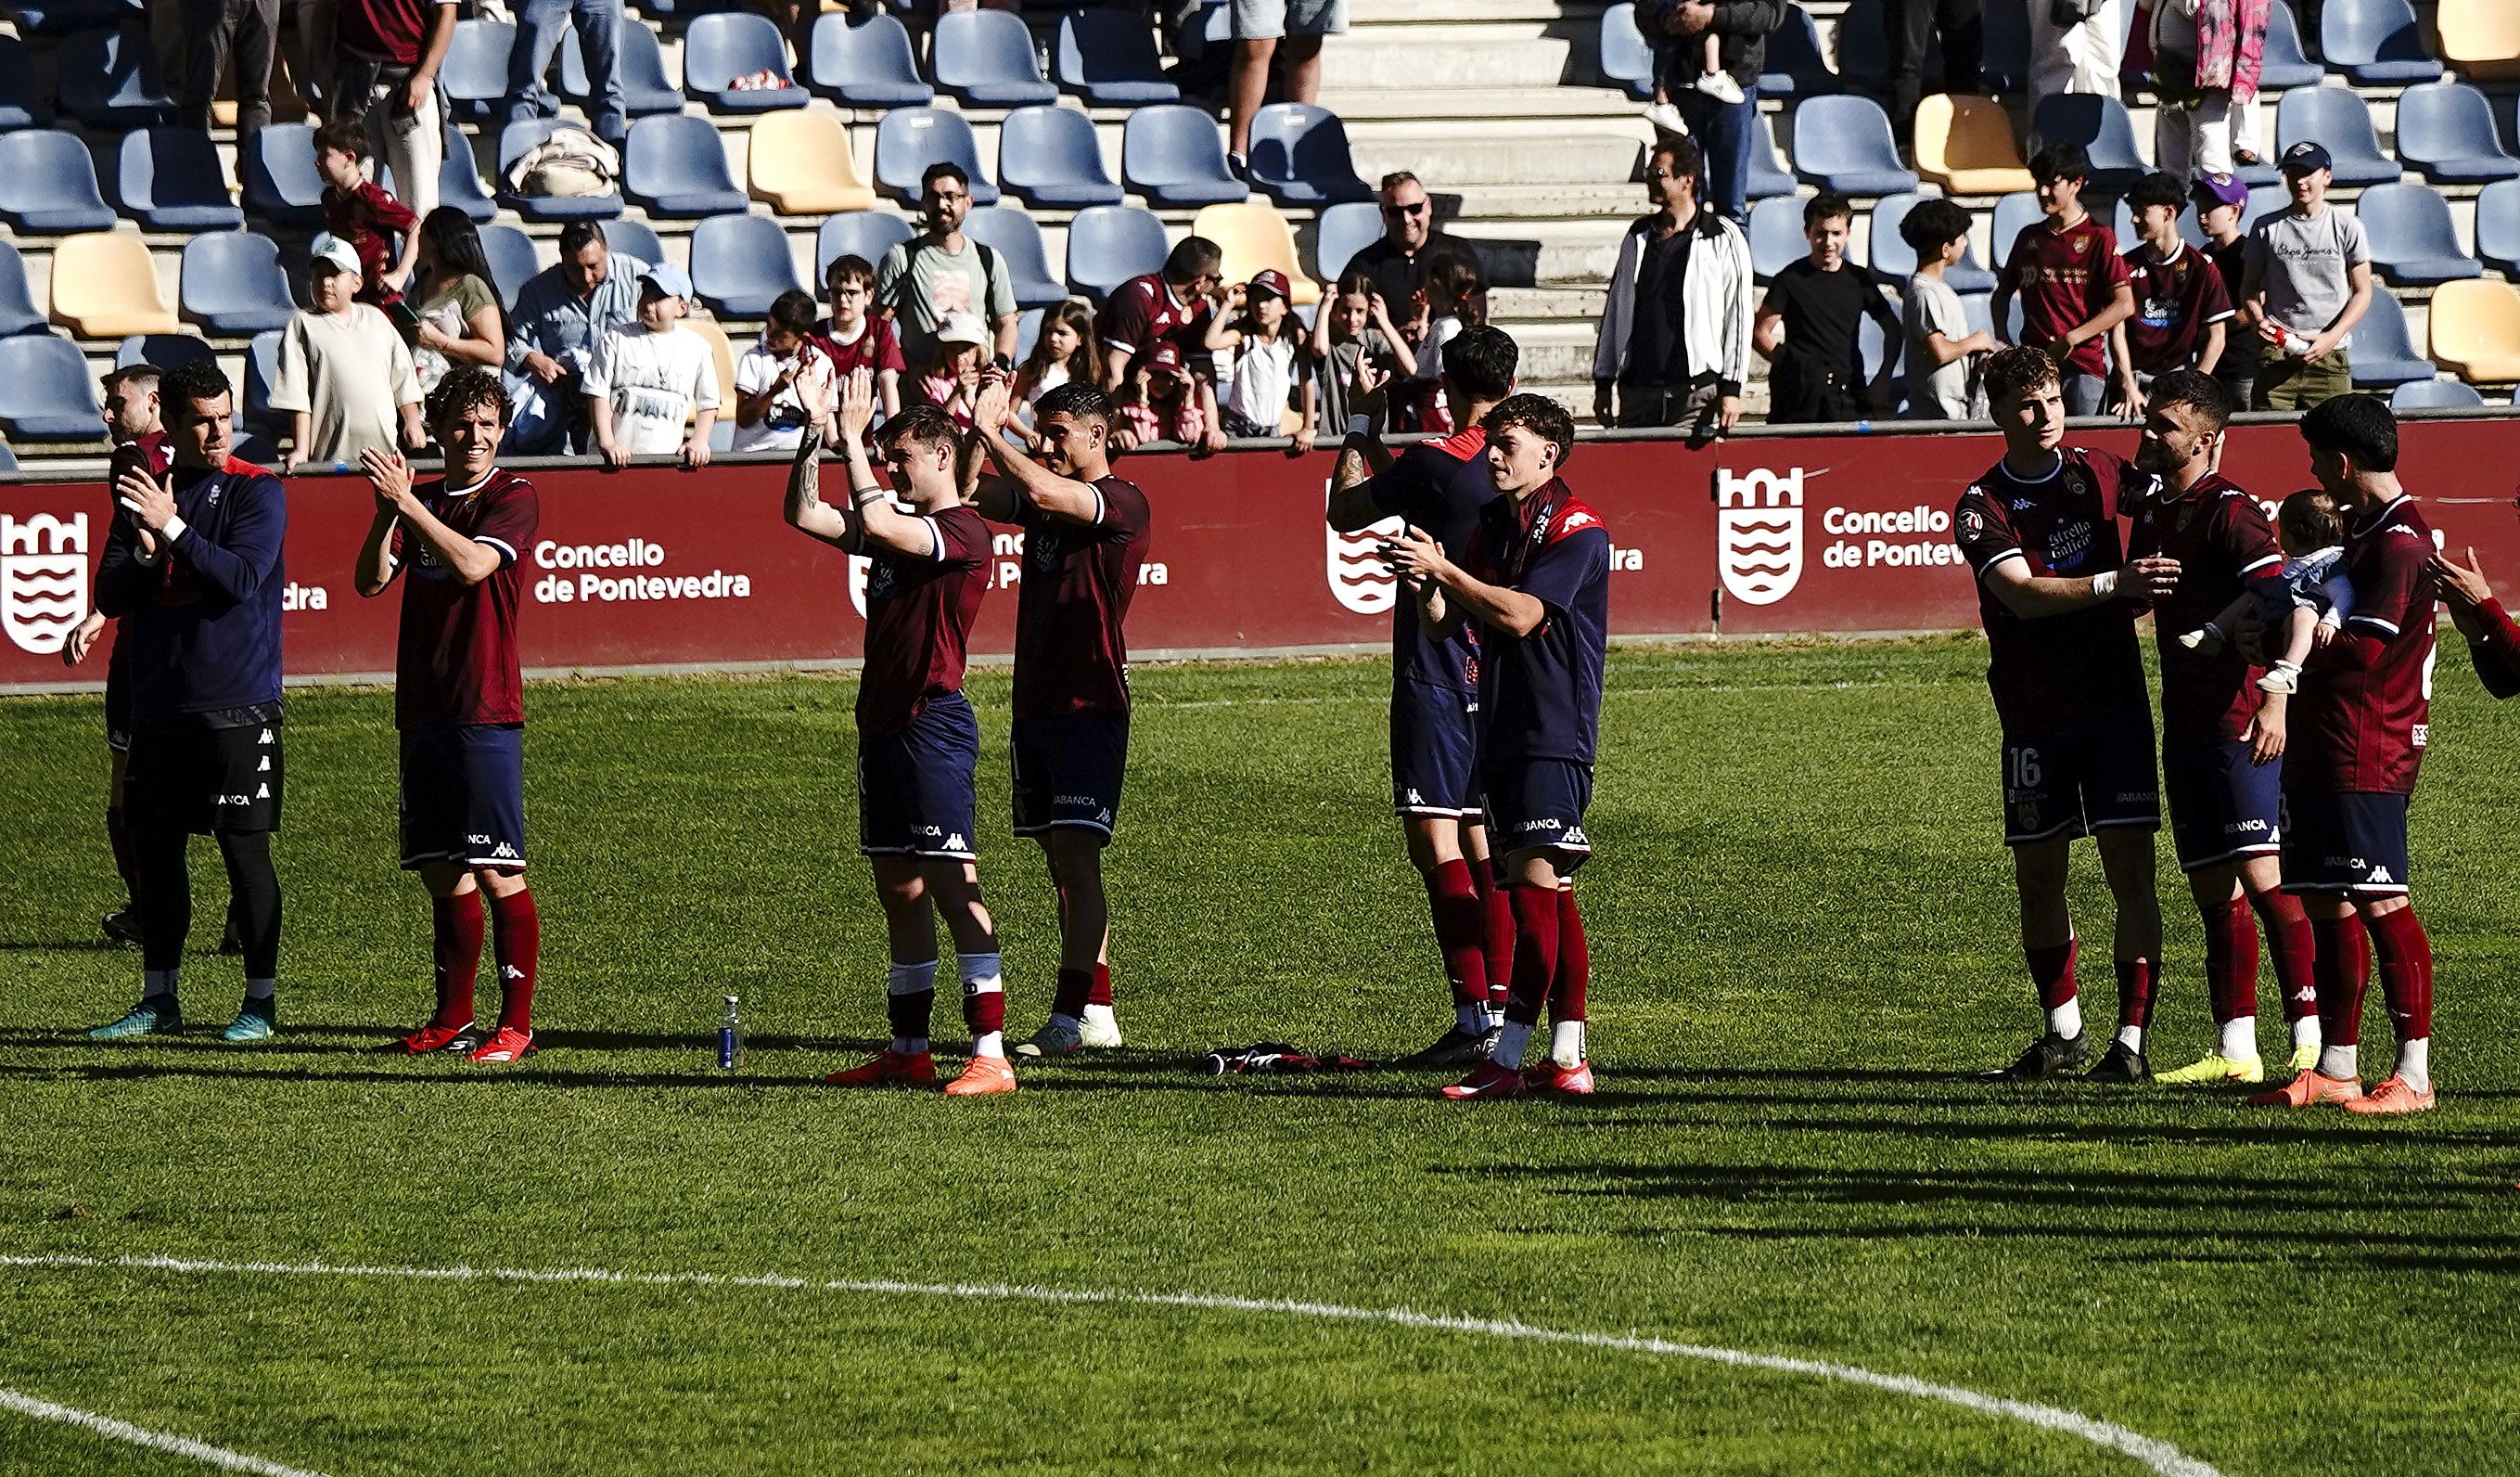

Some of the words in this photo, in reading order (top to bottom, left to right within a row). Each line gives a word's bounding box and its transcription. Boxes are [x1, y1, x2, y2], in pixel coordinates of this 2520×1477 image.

[1823, 505, 1951, 535] Concello
[534, 538, 665, 569] Concello
[1823, 540, 1862, 568] de
[1867, 540, 1965, 568] Pontev
[534, 573, 575, 603] de
[580, 569, 750, 602] Pontevedra
[2010, 747, 2041, 788] 16
[1053, 795, 1095, 806] ABANCA
